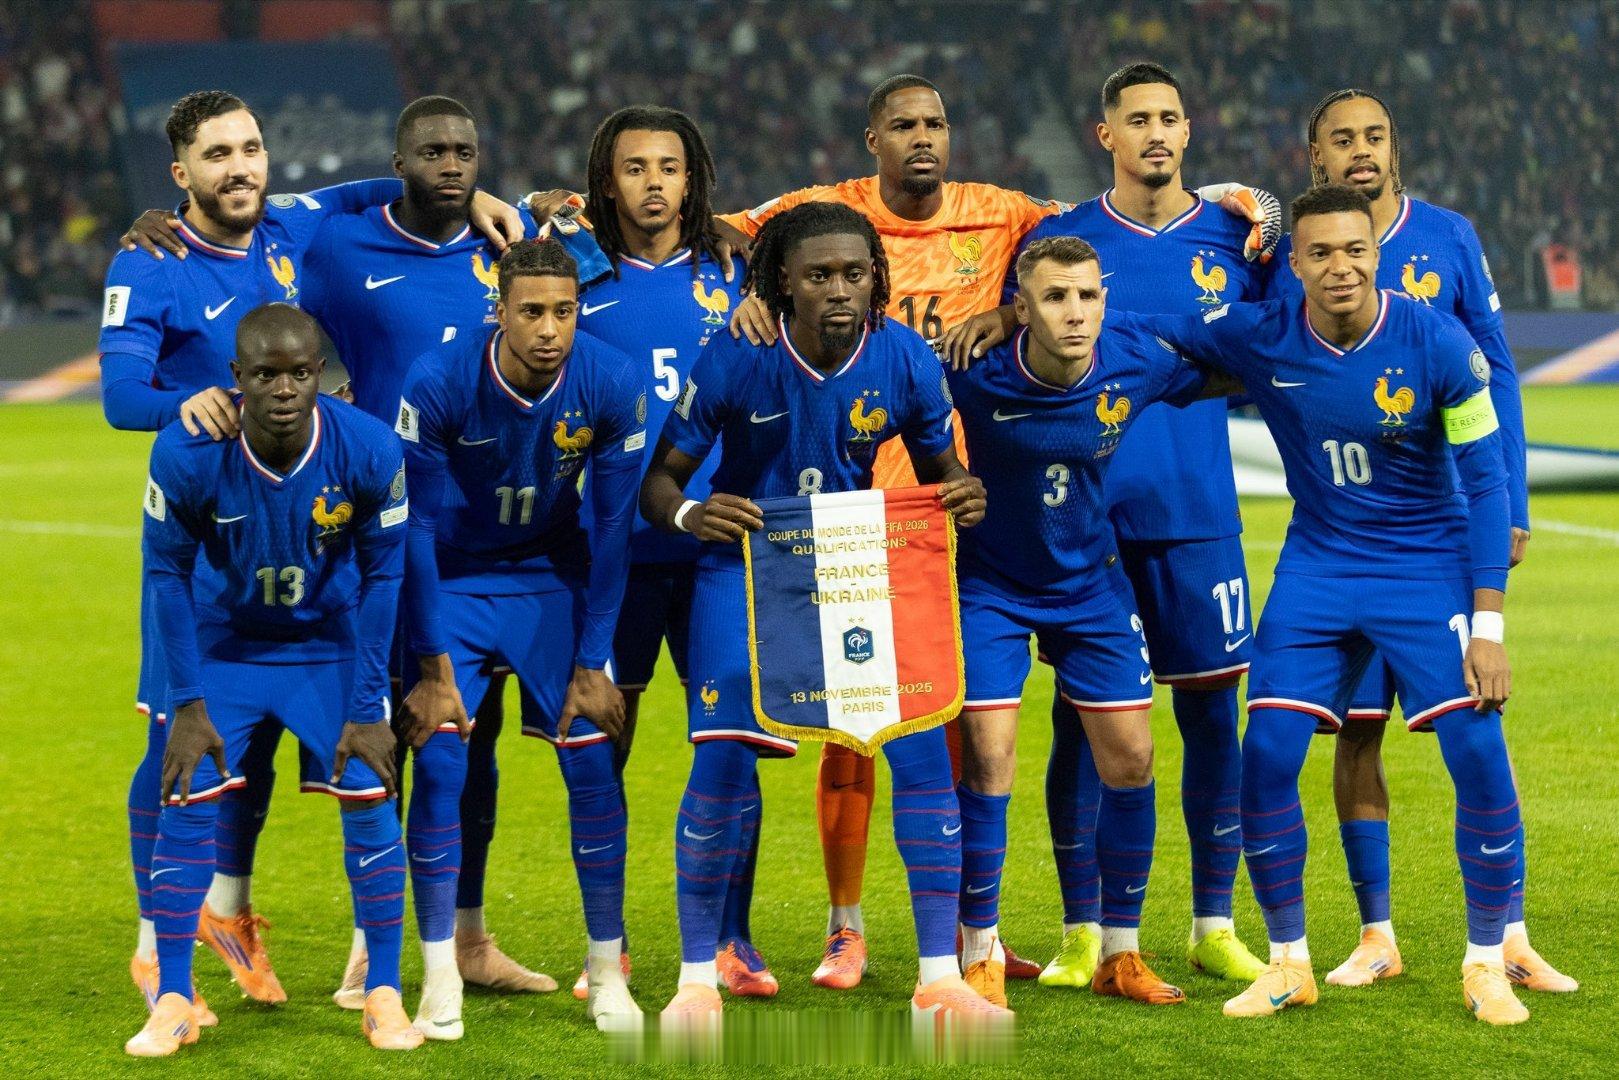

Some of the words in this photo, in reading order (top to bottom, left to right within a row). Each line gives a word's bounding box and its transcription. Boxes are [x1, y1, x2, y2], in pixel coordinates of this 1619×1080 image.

[899, 296, 943, 340] 16
[652, 348, 680, 401] 5
[1322, 440, 1372, 486] 10
[1043, 463, 1070, 508] 3
[495, 486, 536, 526] 11
[767, 530, 799, 541] COUPE
[802, 527, 814, 539] DU
[817, 525, 853, 539] MONDE
[855, 525, 866, 536] DE
[868, 524, 881, 534] LA
[885, 521, 902, 533] FIFA
[905, 519, 929, 531] 2026
[792, 537, 907, 555] QUALIFICATIONS
[256, 566, 305, 607] 13
[814, 563, 890, 581] FRANCE
[811, 587, 896, 605] UKRAINE
[1212, 577, 1245, 633] 17
[1448, 613, 1471, 660] 1
[790, 691, 806, 704] 13
[809, 685, 892, 703] NOVEMBRE
[896, 682, 933, 694] 2025
[842, 701, 885, 714] PARIS
